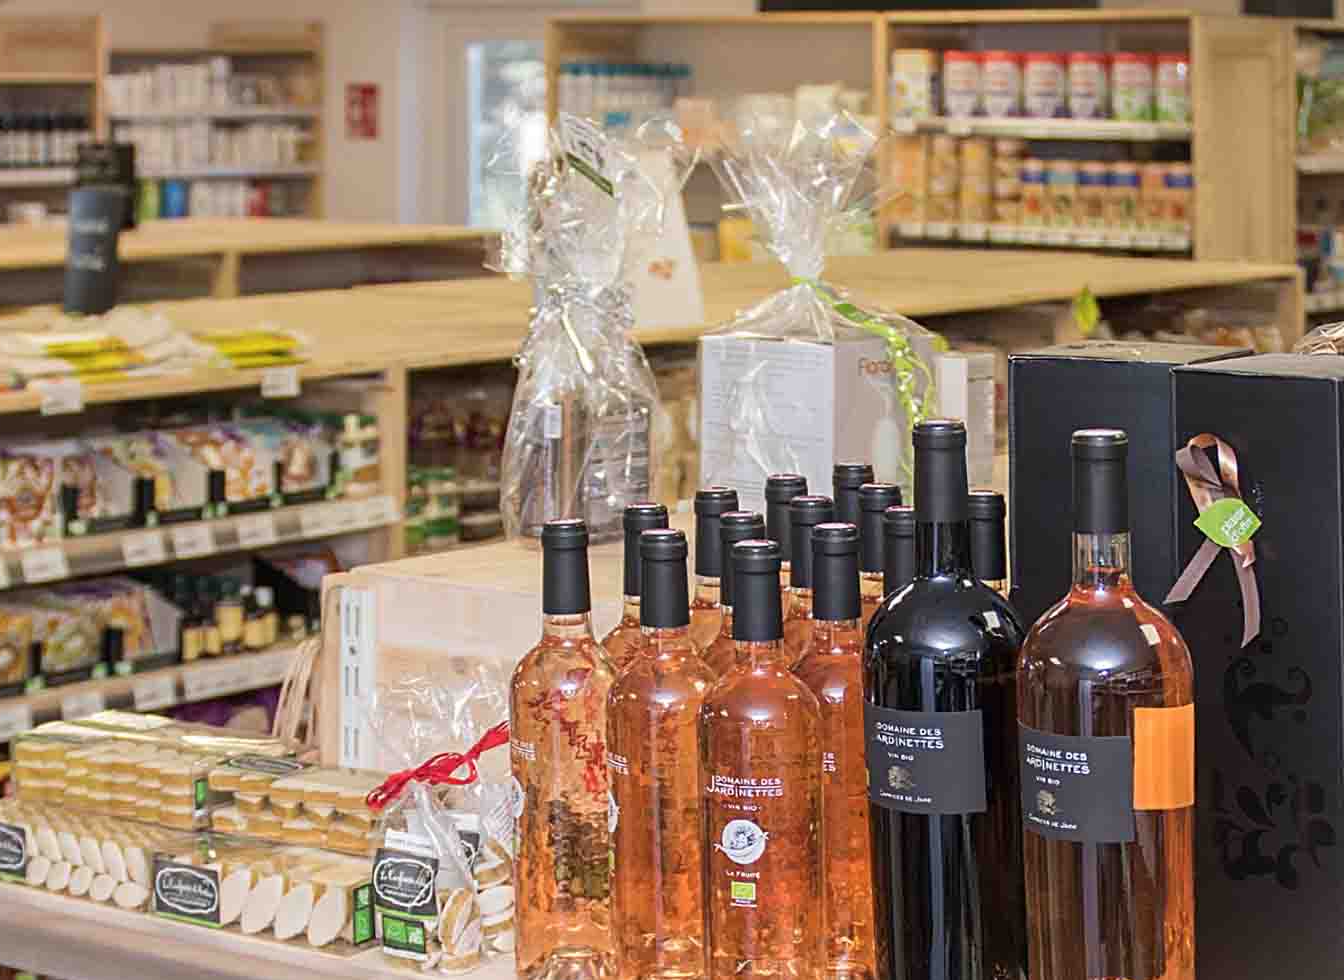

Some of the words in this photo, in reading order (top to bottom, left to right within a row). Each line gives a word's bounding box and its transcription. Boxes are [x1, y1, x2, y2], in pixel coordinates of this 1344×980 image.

[919, 728, 942, 736] DES
[877, 734, 945, 749] ARDINETTES
[1065, 751, 1088, 761] DES
[1026, 756, 1091, 774] ARDINETTES
[707, 775, 784, 798] JARDINETTES
[715, 775, 756, 786] DOMAINE
[760, 778, 782, 786] DES
